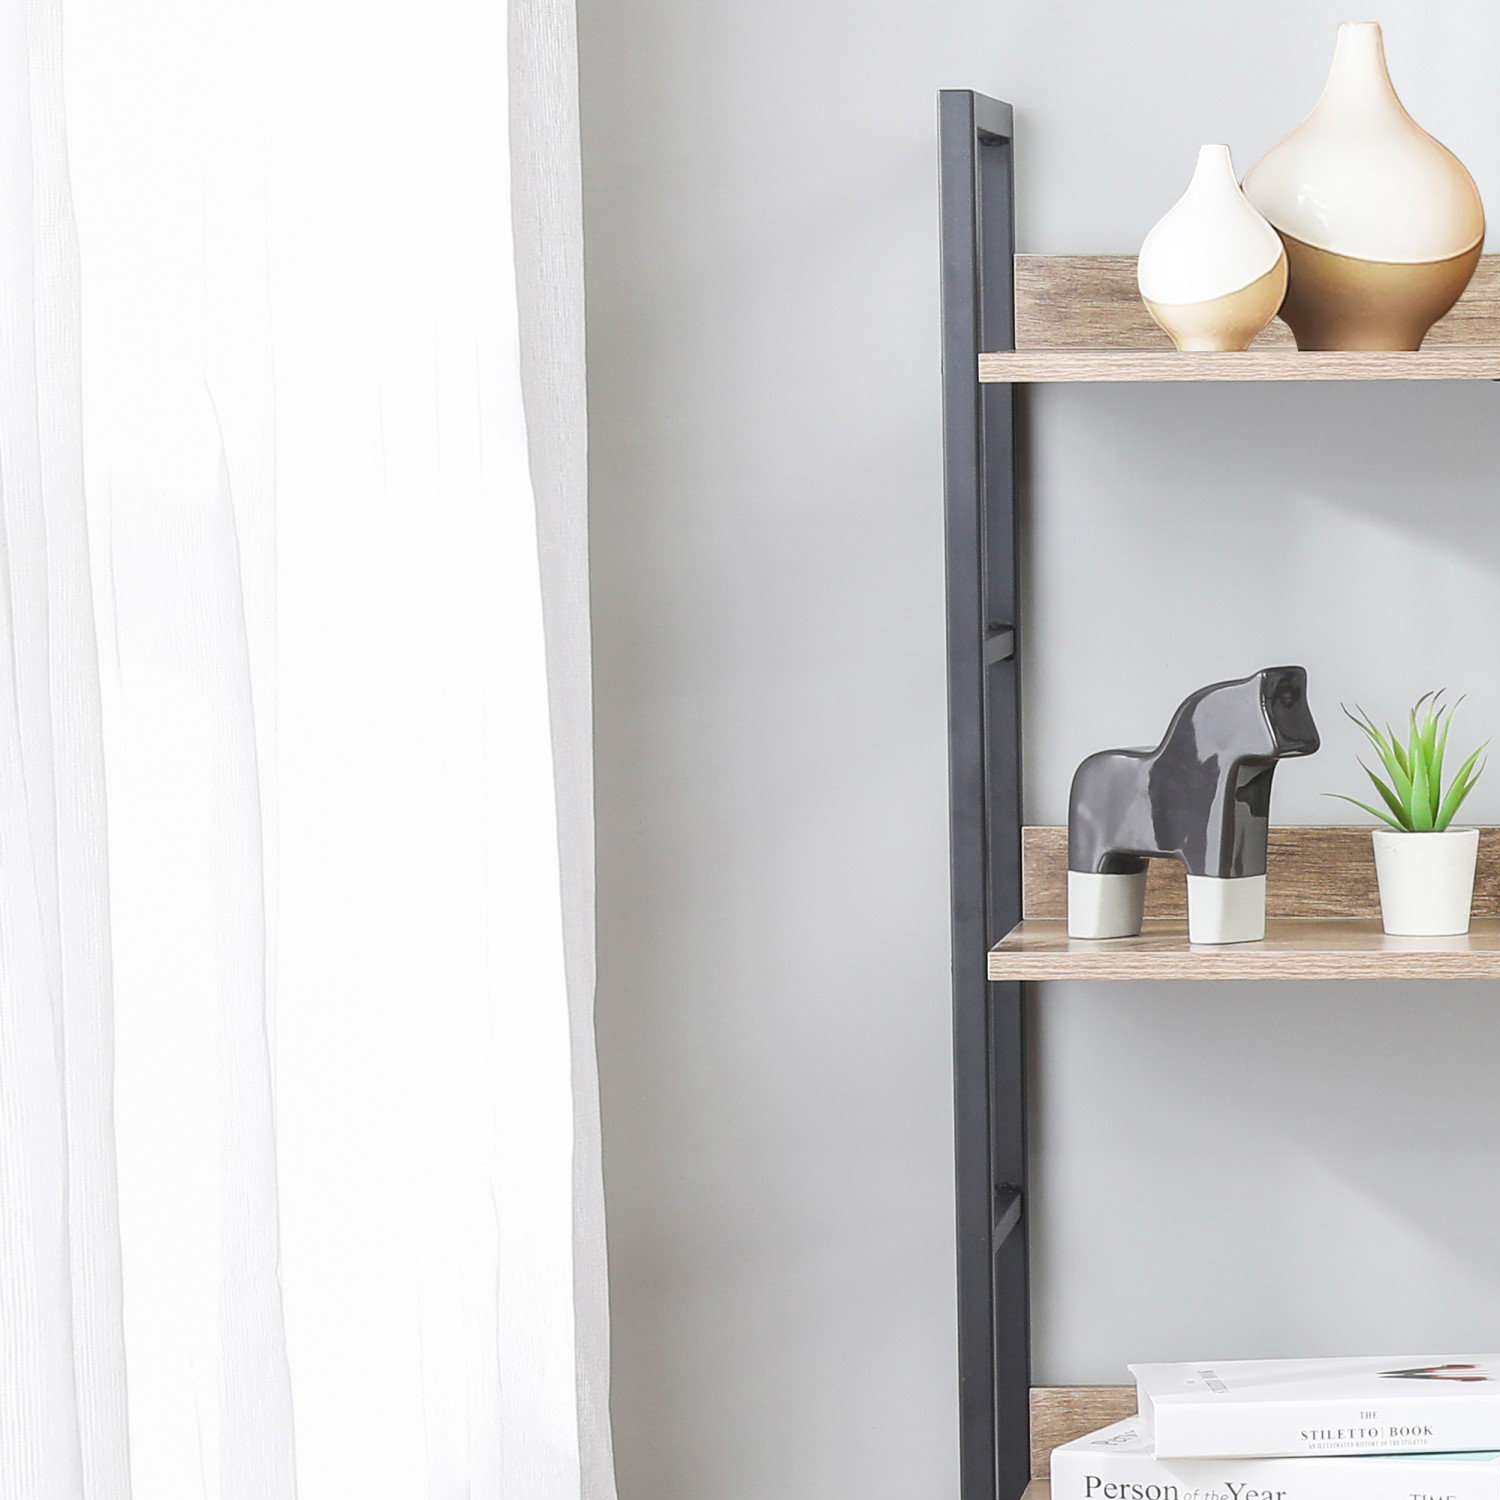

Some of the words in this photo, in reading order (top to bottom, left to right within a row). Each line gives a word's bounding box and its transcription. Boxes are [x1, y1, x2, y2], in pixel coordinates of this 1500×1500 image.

[1360, 1411, 1378, 1420] THE
[1301, 1428, 1379, 1441] STILETTO
[1389, 1425, 1434, 1437] BOOK
